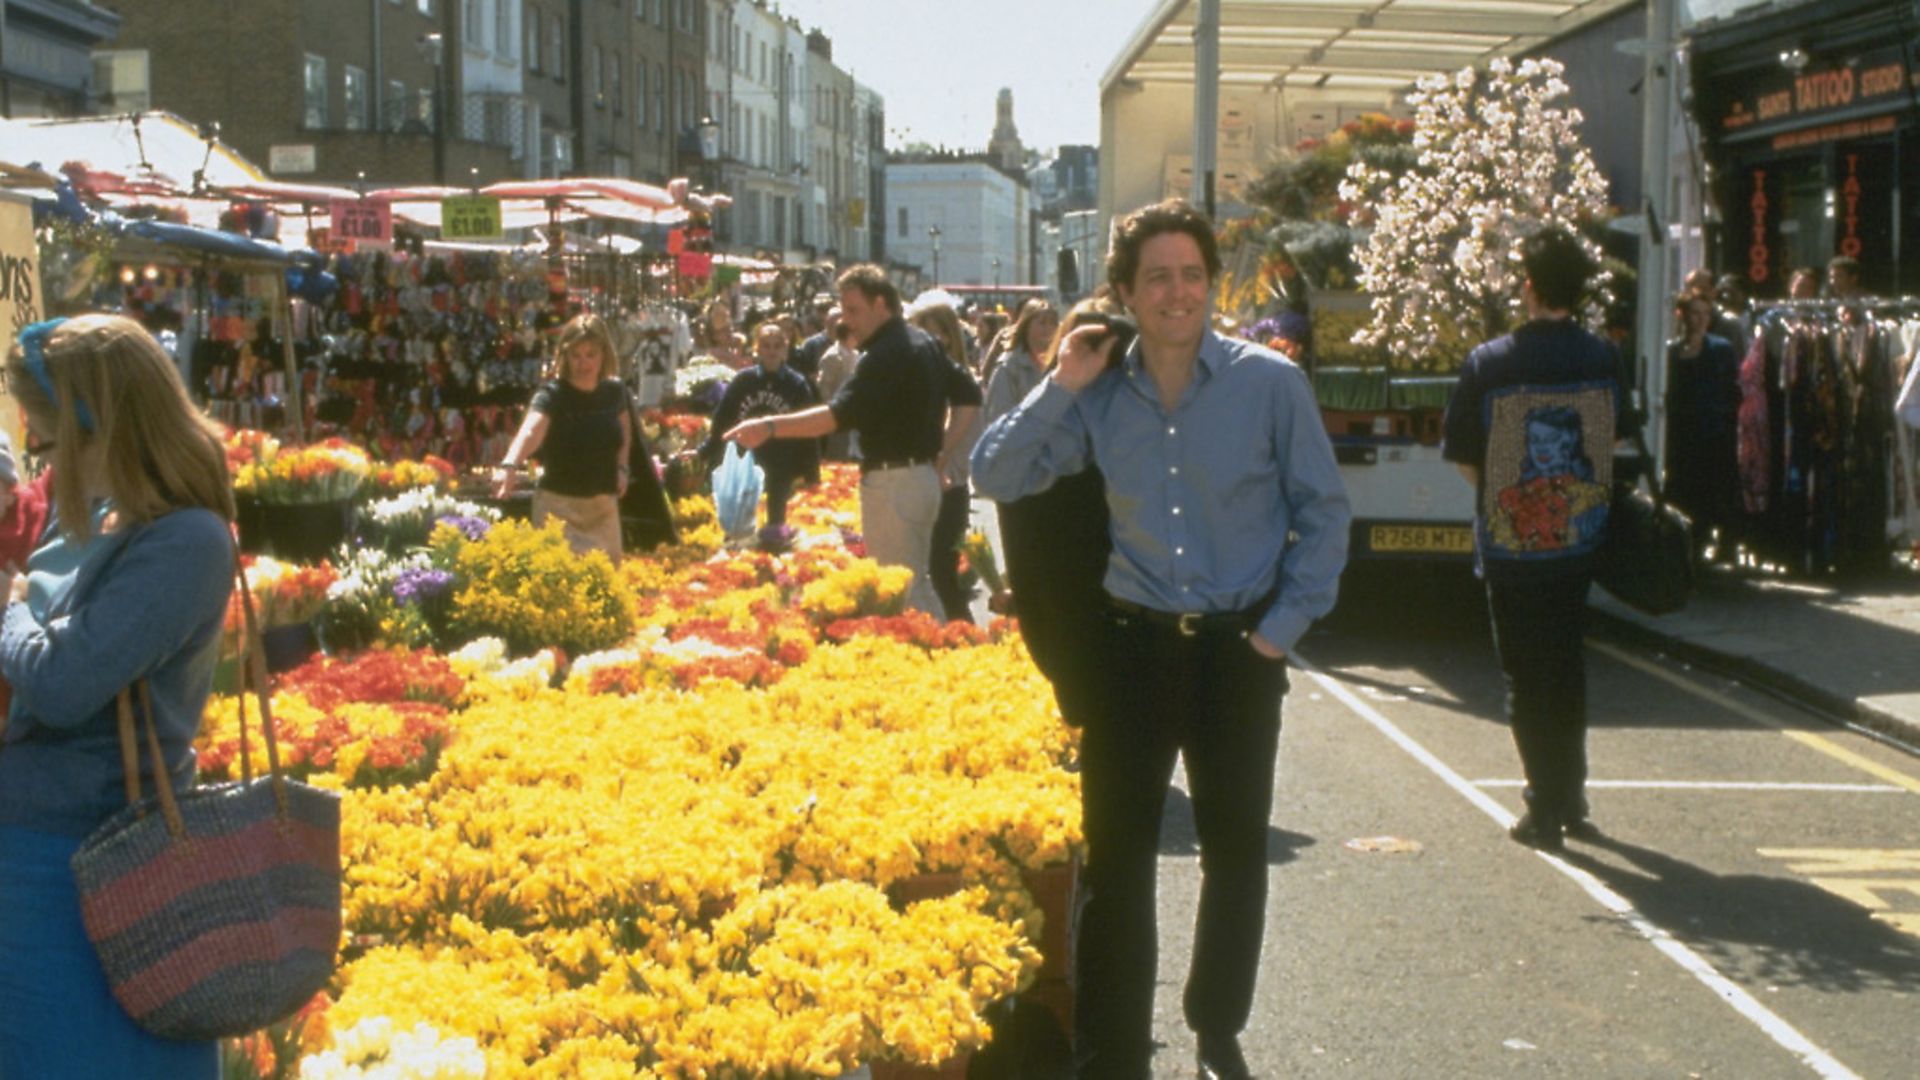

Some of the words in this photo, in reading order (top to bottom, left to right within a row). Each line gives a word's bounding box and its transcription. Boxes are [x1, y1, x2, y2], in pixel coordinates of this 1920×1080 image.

[1796, 67, 1853, 111] TATTOO
[1861, 64, 1902, 97] STUDIO
[1750, 169, 1769, 282] TATTOO
[1842, 154, 1861, 257] TATTO
[1375, 528, 1425, 547] R758
